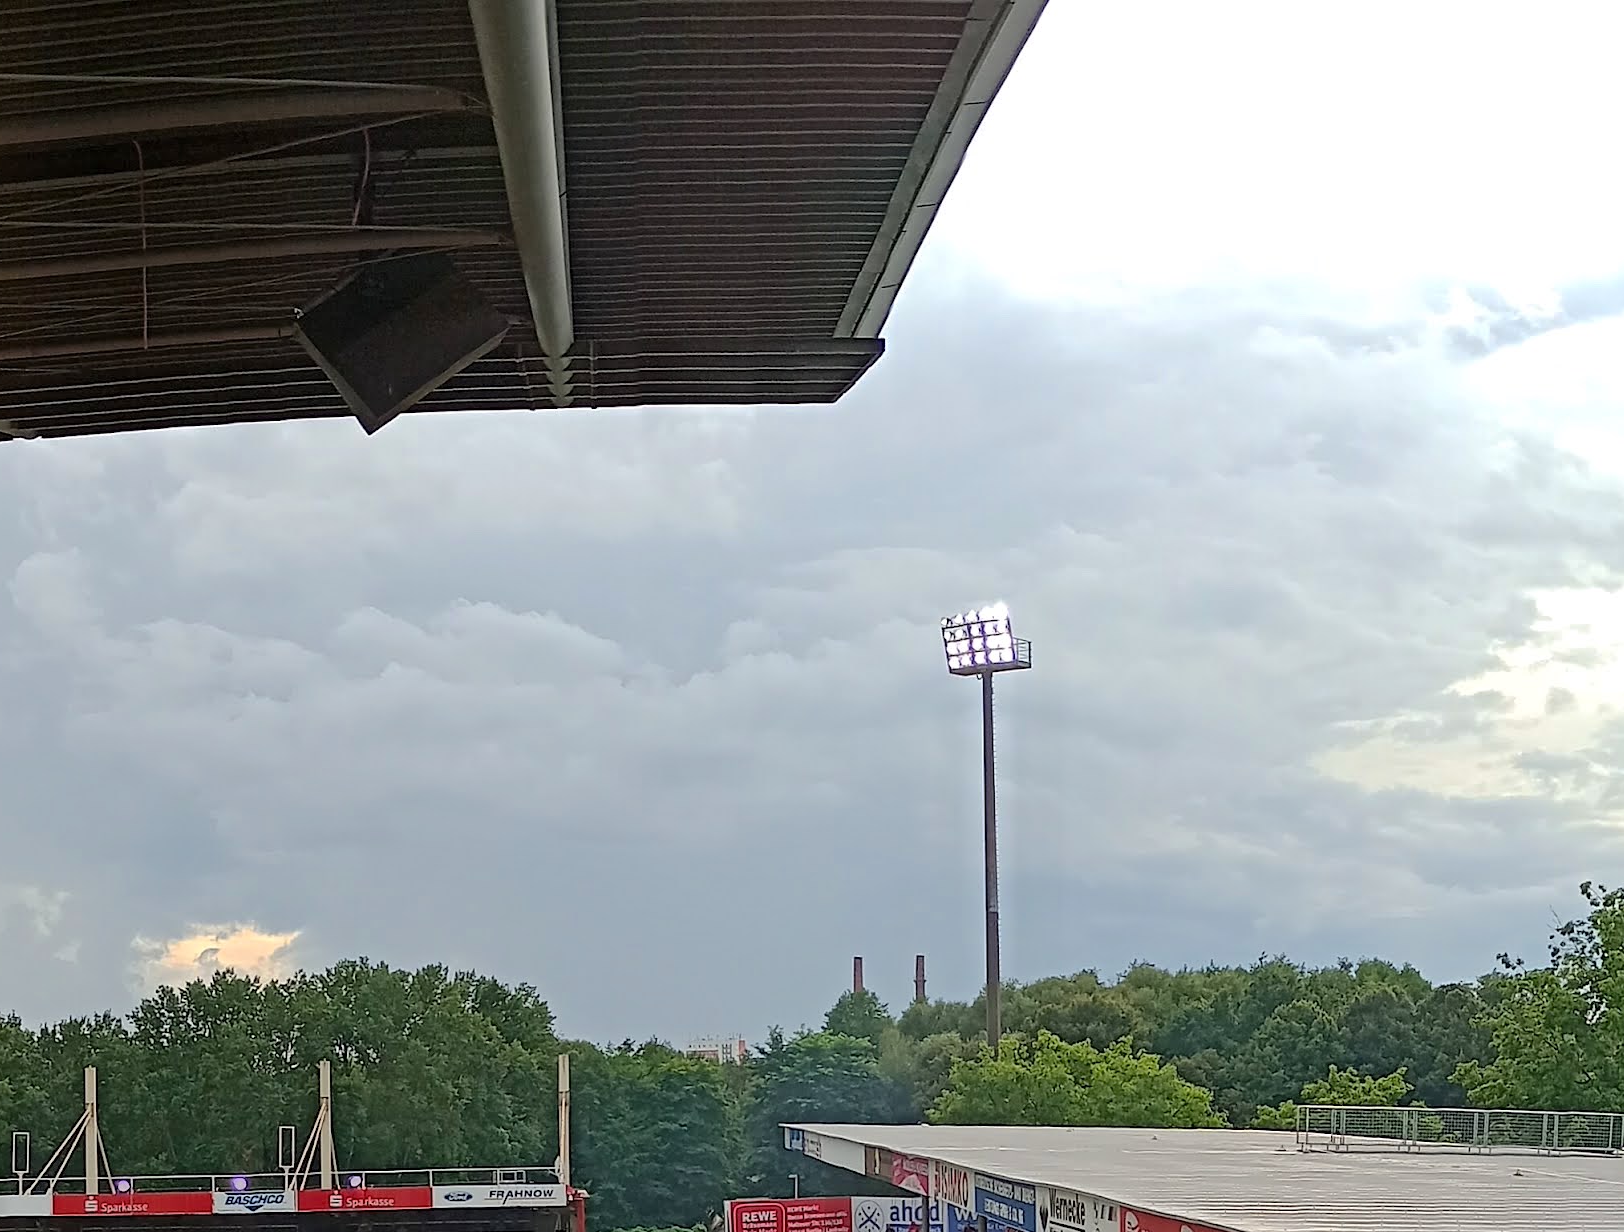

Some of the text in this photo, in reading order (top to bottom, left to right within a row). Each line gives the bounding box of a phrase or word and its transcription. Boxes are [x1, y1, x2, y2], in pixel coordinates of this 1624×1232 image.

[225, 1194, 285, 1206] BASCHCO
[345, 1197, 395, 1208] Sparkasse
[489, 1189, 554, 1205] FRAHNOW
[100, 1202, 149, 1214] Sparkasse
[742, 1211, 777, 1223] REWE
